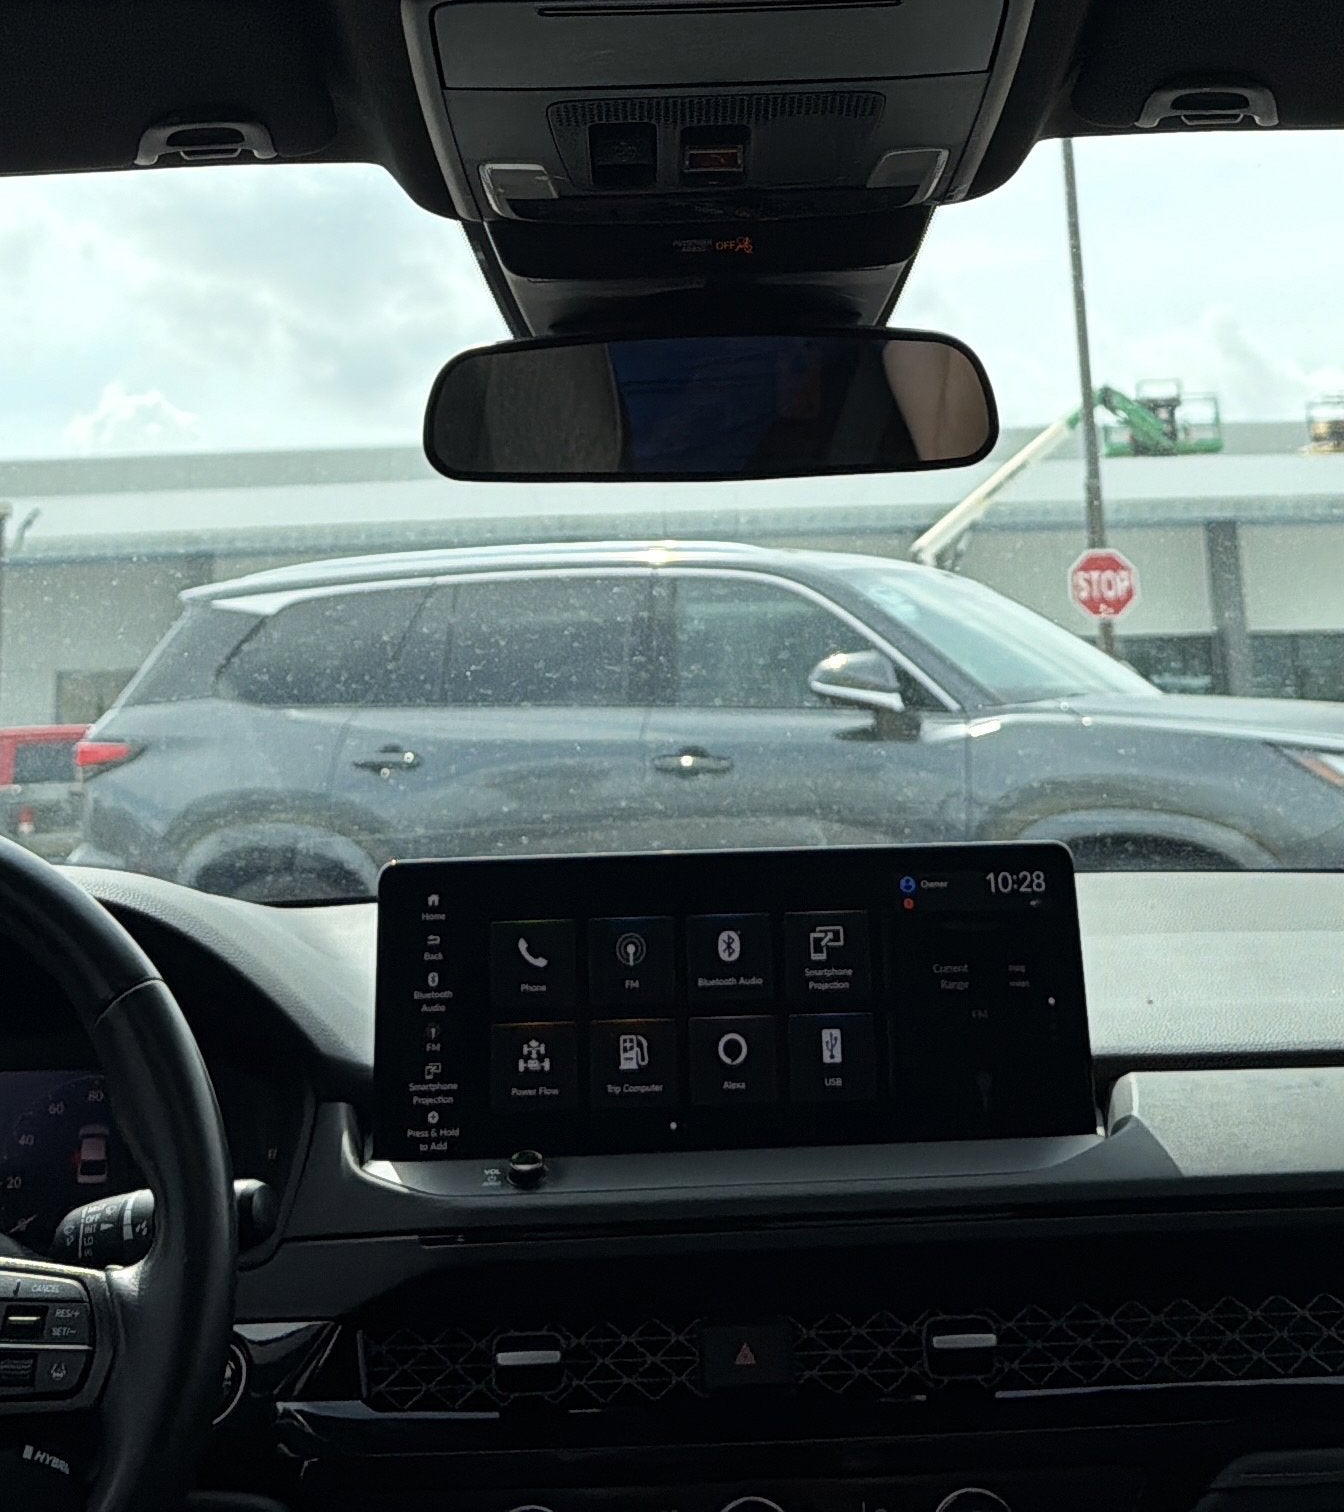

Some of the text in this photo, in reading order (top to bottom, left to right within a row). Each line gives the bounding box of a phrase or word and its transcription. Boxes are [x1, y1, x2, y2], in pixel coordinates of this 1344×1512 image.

[716, 240, 736, 251] OFF
[1074, 569, 1131, 601] STOP
[985, 870, 1046, 894] 10:28
[625, 979, 640, 989] FM
[697, 975, 764, 987] Bluetooth Audio
[824, 1077, 843, 1087] USB
[48, 1101, 65, 1115] 60
[18, 1134, 34, 1147] 40
[7, 1176, 22, 1189] 20
